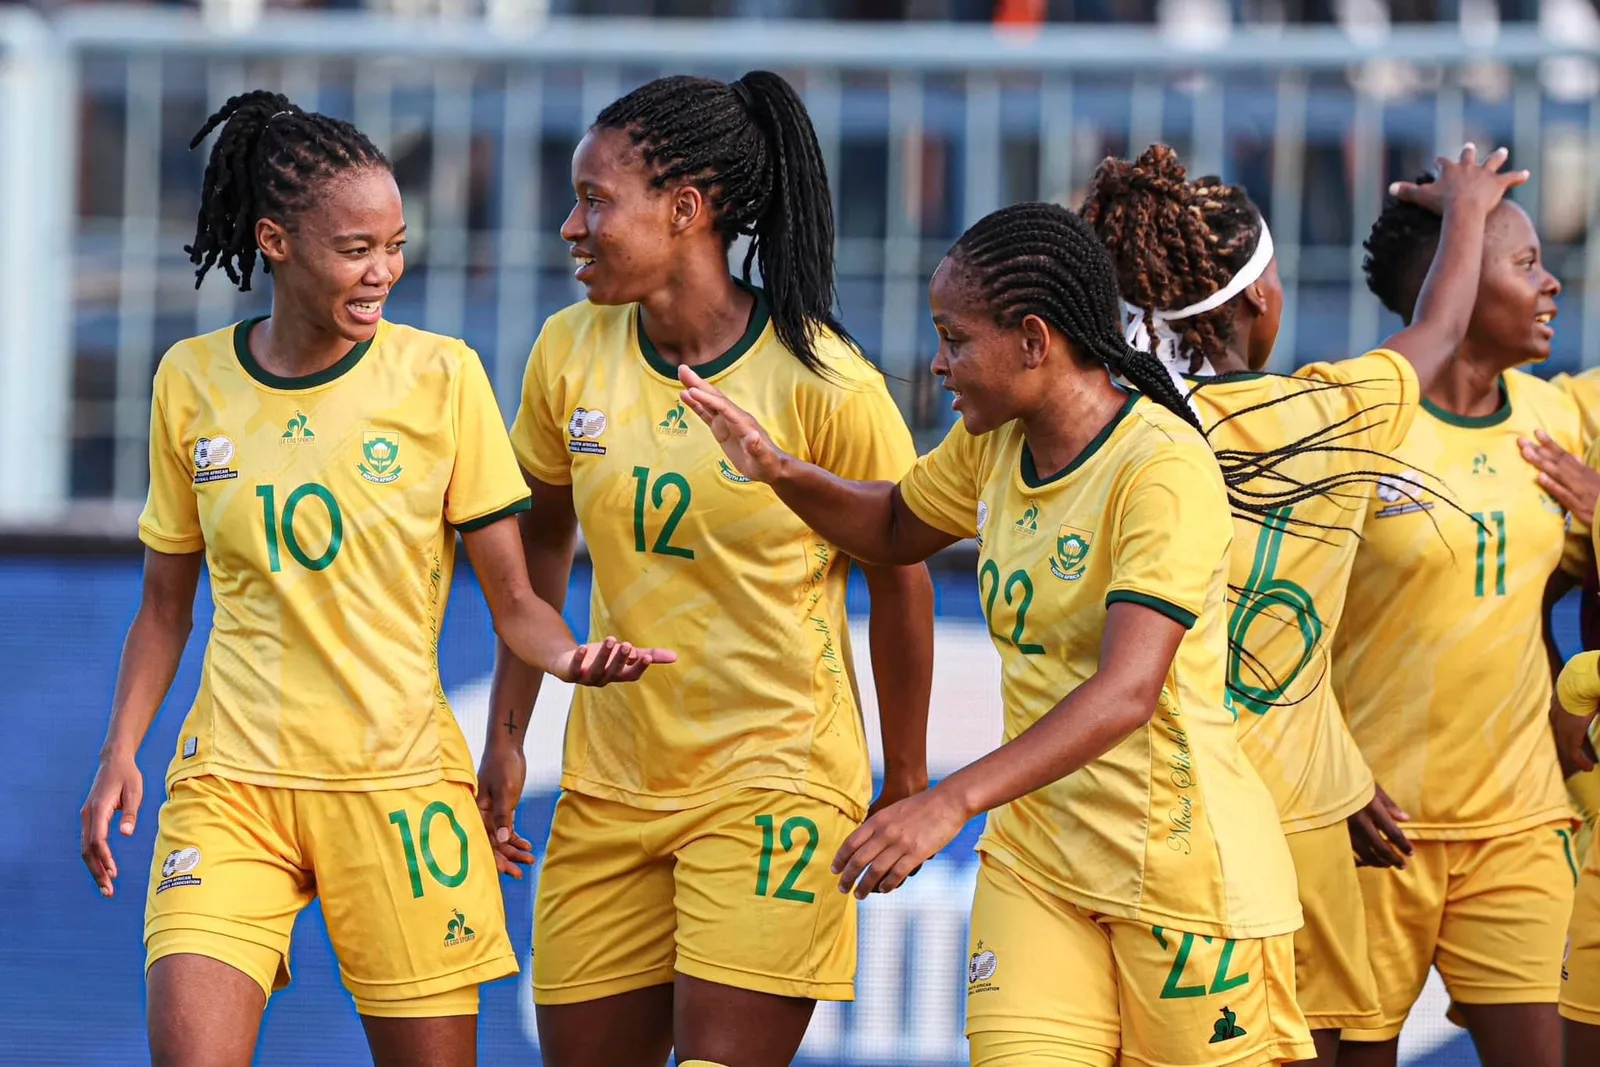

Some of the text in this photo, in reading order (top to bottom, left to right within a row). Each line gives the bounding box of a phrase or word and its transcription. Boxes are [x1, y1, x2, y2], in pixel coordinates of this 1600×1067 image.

[209, 472, 237, 481] ASSOCIATION
[362, 472, 398, 482] SOUTH AFRICA
[632, 465, 695, 561] 12
[722, 470, 738, 481] SOUTH
[255, 481, 343, 574] 10
[1470, 510, 1506, 597] 11
[979, 558, 1046, 655] 22
[1051, 567, 1064, 580] SOUTH
[388, 800, 469, 899] 10
[754, 814, 820, 904] 12
[460, 934, 476, 944] SPORTIF
[1150, 925, 1250, 1000] 22
